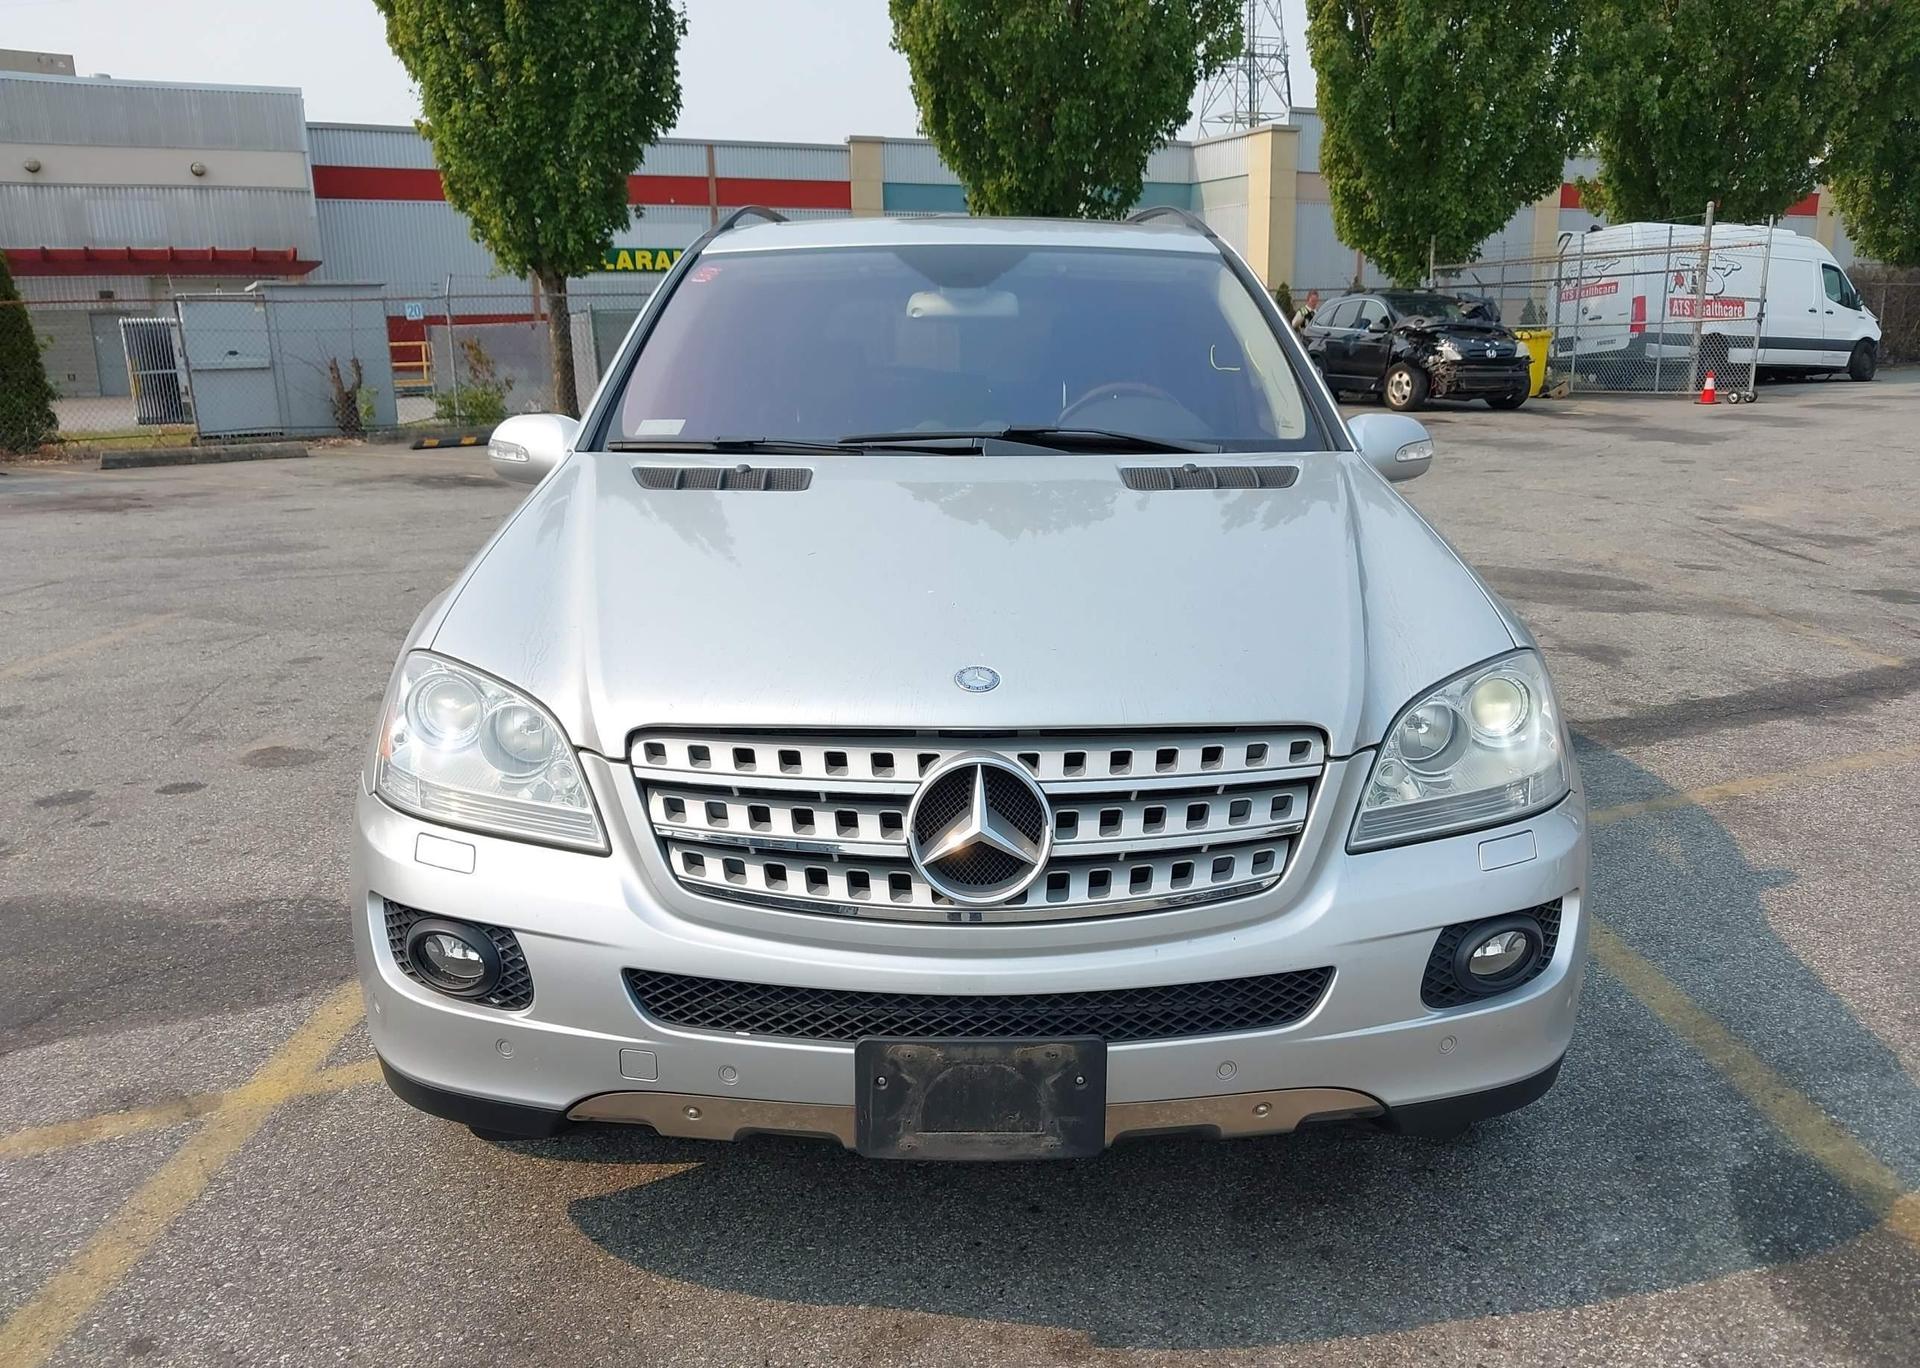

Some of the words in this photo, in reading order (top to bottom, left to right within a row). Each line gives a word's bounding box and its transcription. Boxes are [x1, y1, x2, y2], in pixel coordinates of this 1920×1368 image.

[407, 304, 421, 317] 20
[1672, 300, 1691, 315] ATS
[1694, 300, 1743, 317] althcare
